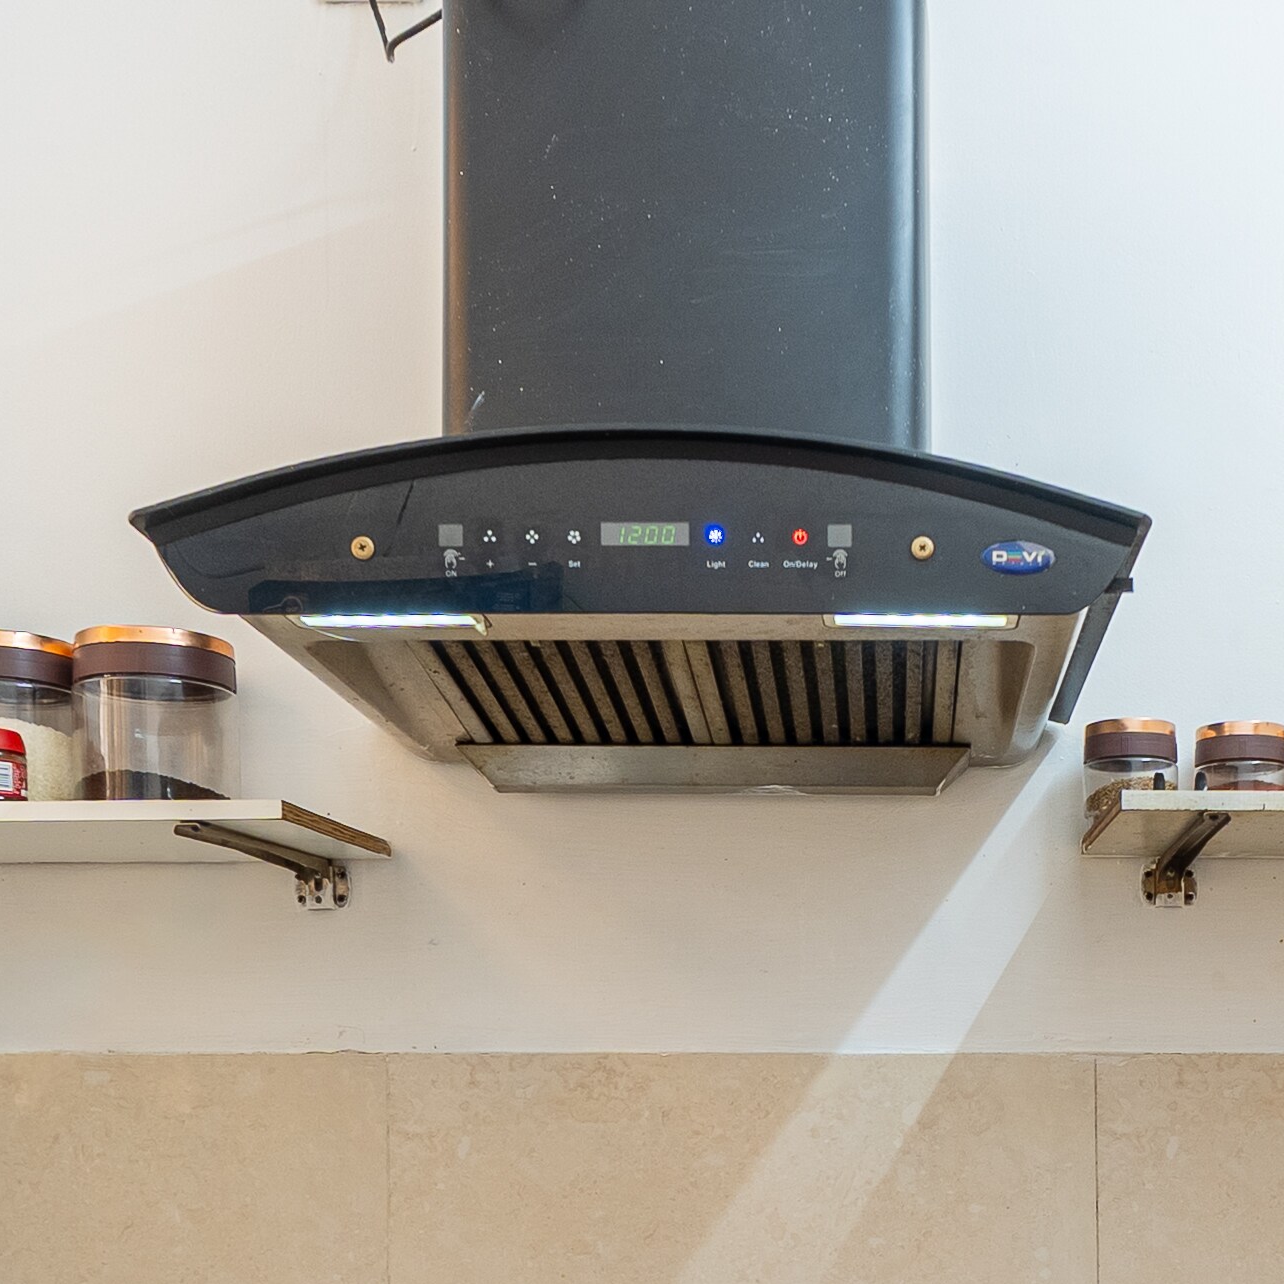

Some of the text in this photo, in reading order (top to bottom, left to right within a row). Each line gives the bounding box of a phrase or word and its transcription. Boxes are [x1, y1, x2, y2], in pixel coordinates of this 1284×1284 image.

[568, 560, 581, 568] Set
[706, 560, 726, 570] Light
[748, 560, 770, 569] Clean
[783, 560, 818, 570] On/Delay
[445, 569, 457, 577] ON
[834, 570, 847, 578] Off
